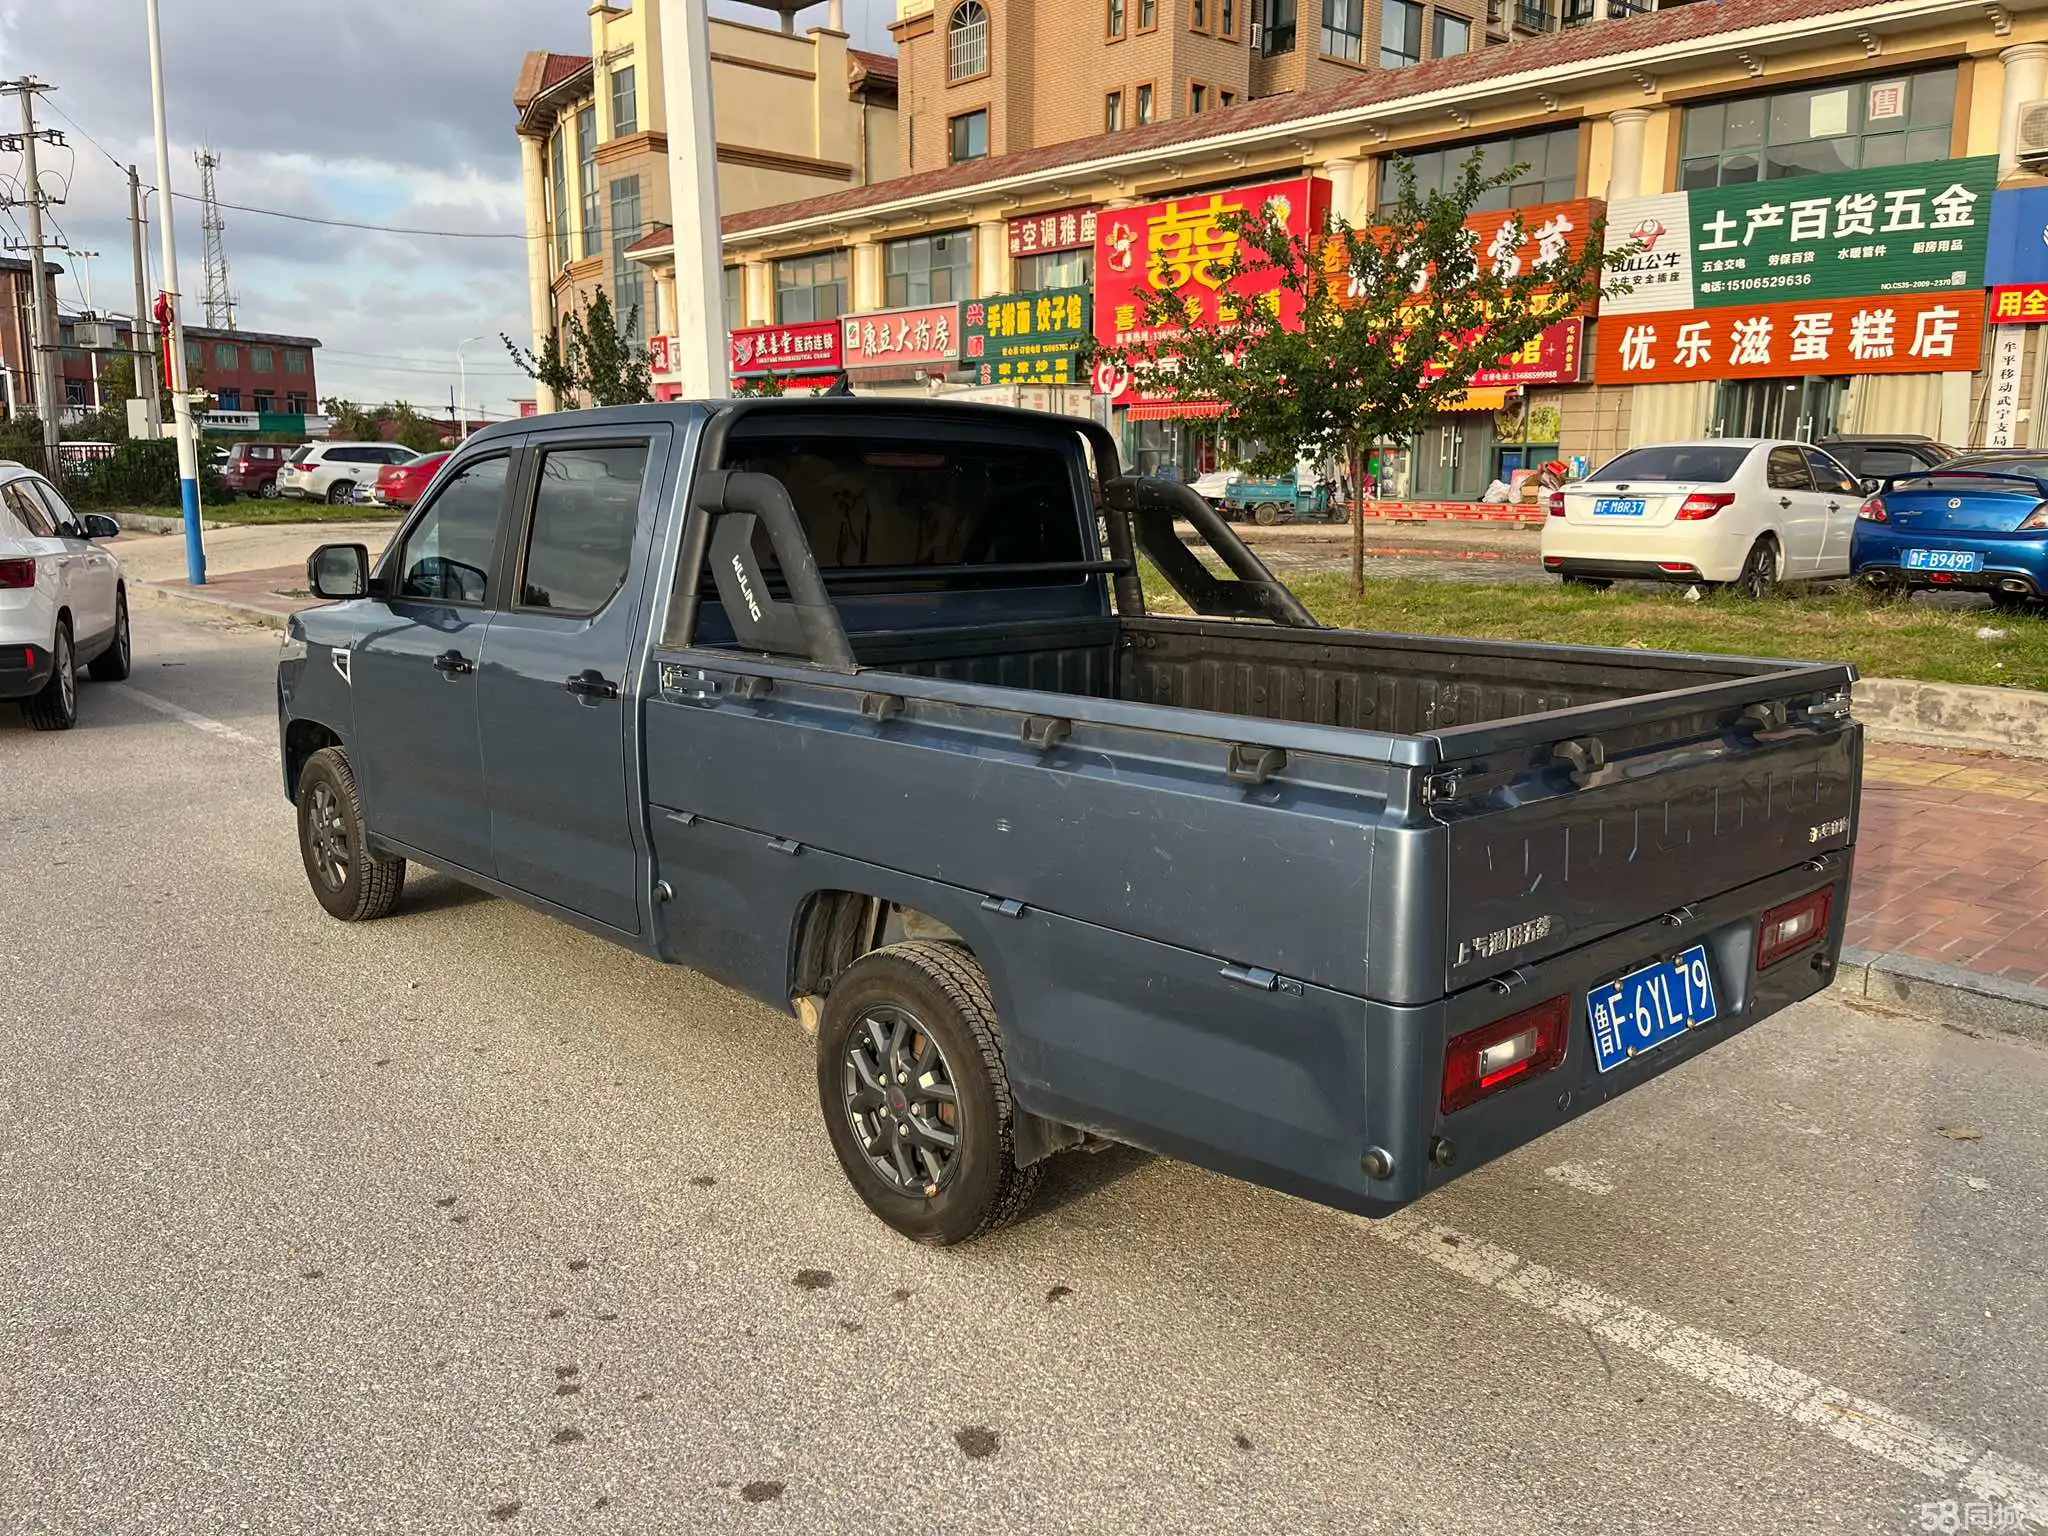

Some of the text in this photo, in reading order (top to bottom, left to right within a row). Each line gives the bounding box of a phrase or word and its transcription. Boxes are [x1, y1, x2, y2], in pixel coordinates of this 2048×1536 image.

[1871, 85, 1900, 119] 售
[1022, 210, 1097, 251] 空调雅座
[1697, 182, 1979, 251] 土产百货五金
[1701, 238, 1964, 273] 五金交电 劳保百货 水暖管件 厨房用品
[1609, 271, 1681, 286] 公牛安全插座
[794, 333, 833, 352] 医药连锁
[861, 314, 950, 359] 康立大药房
[1618, 305, 1960, 372] 优乐滋蛋糕店
[732, 554, 762, 622] WULING
